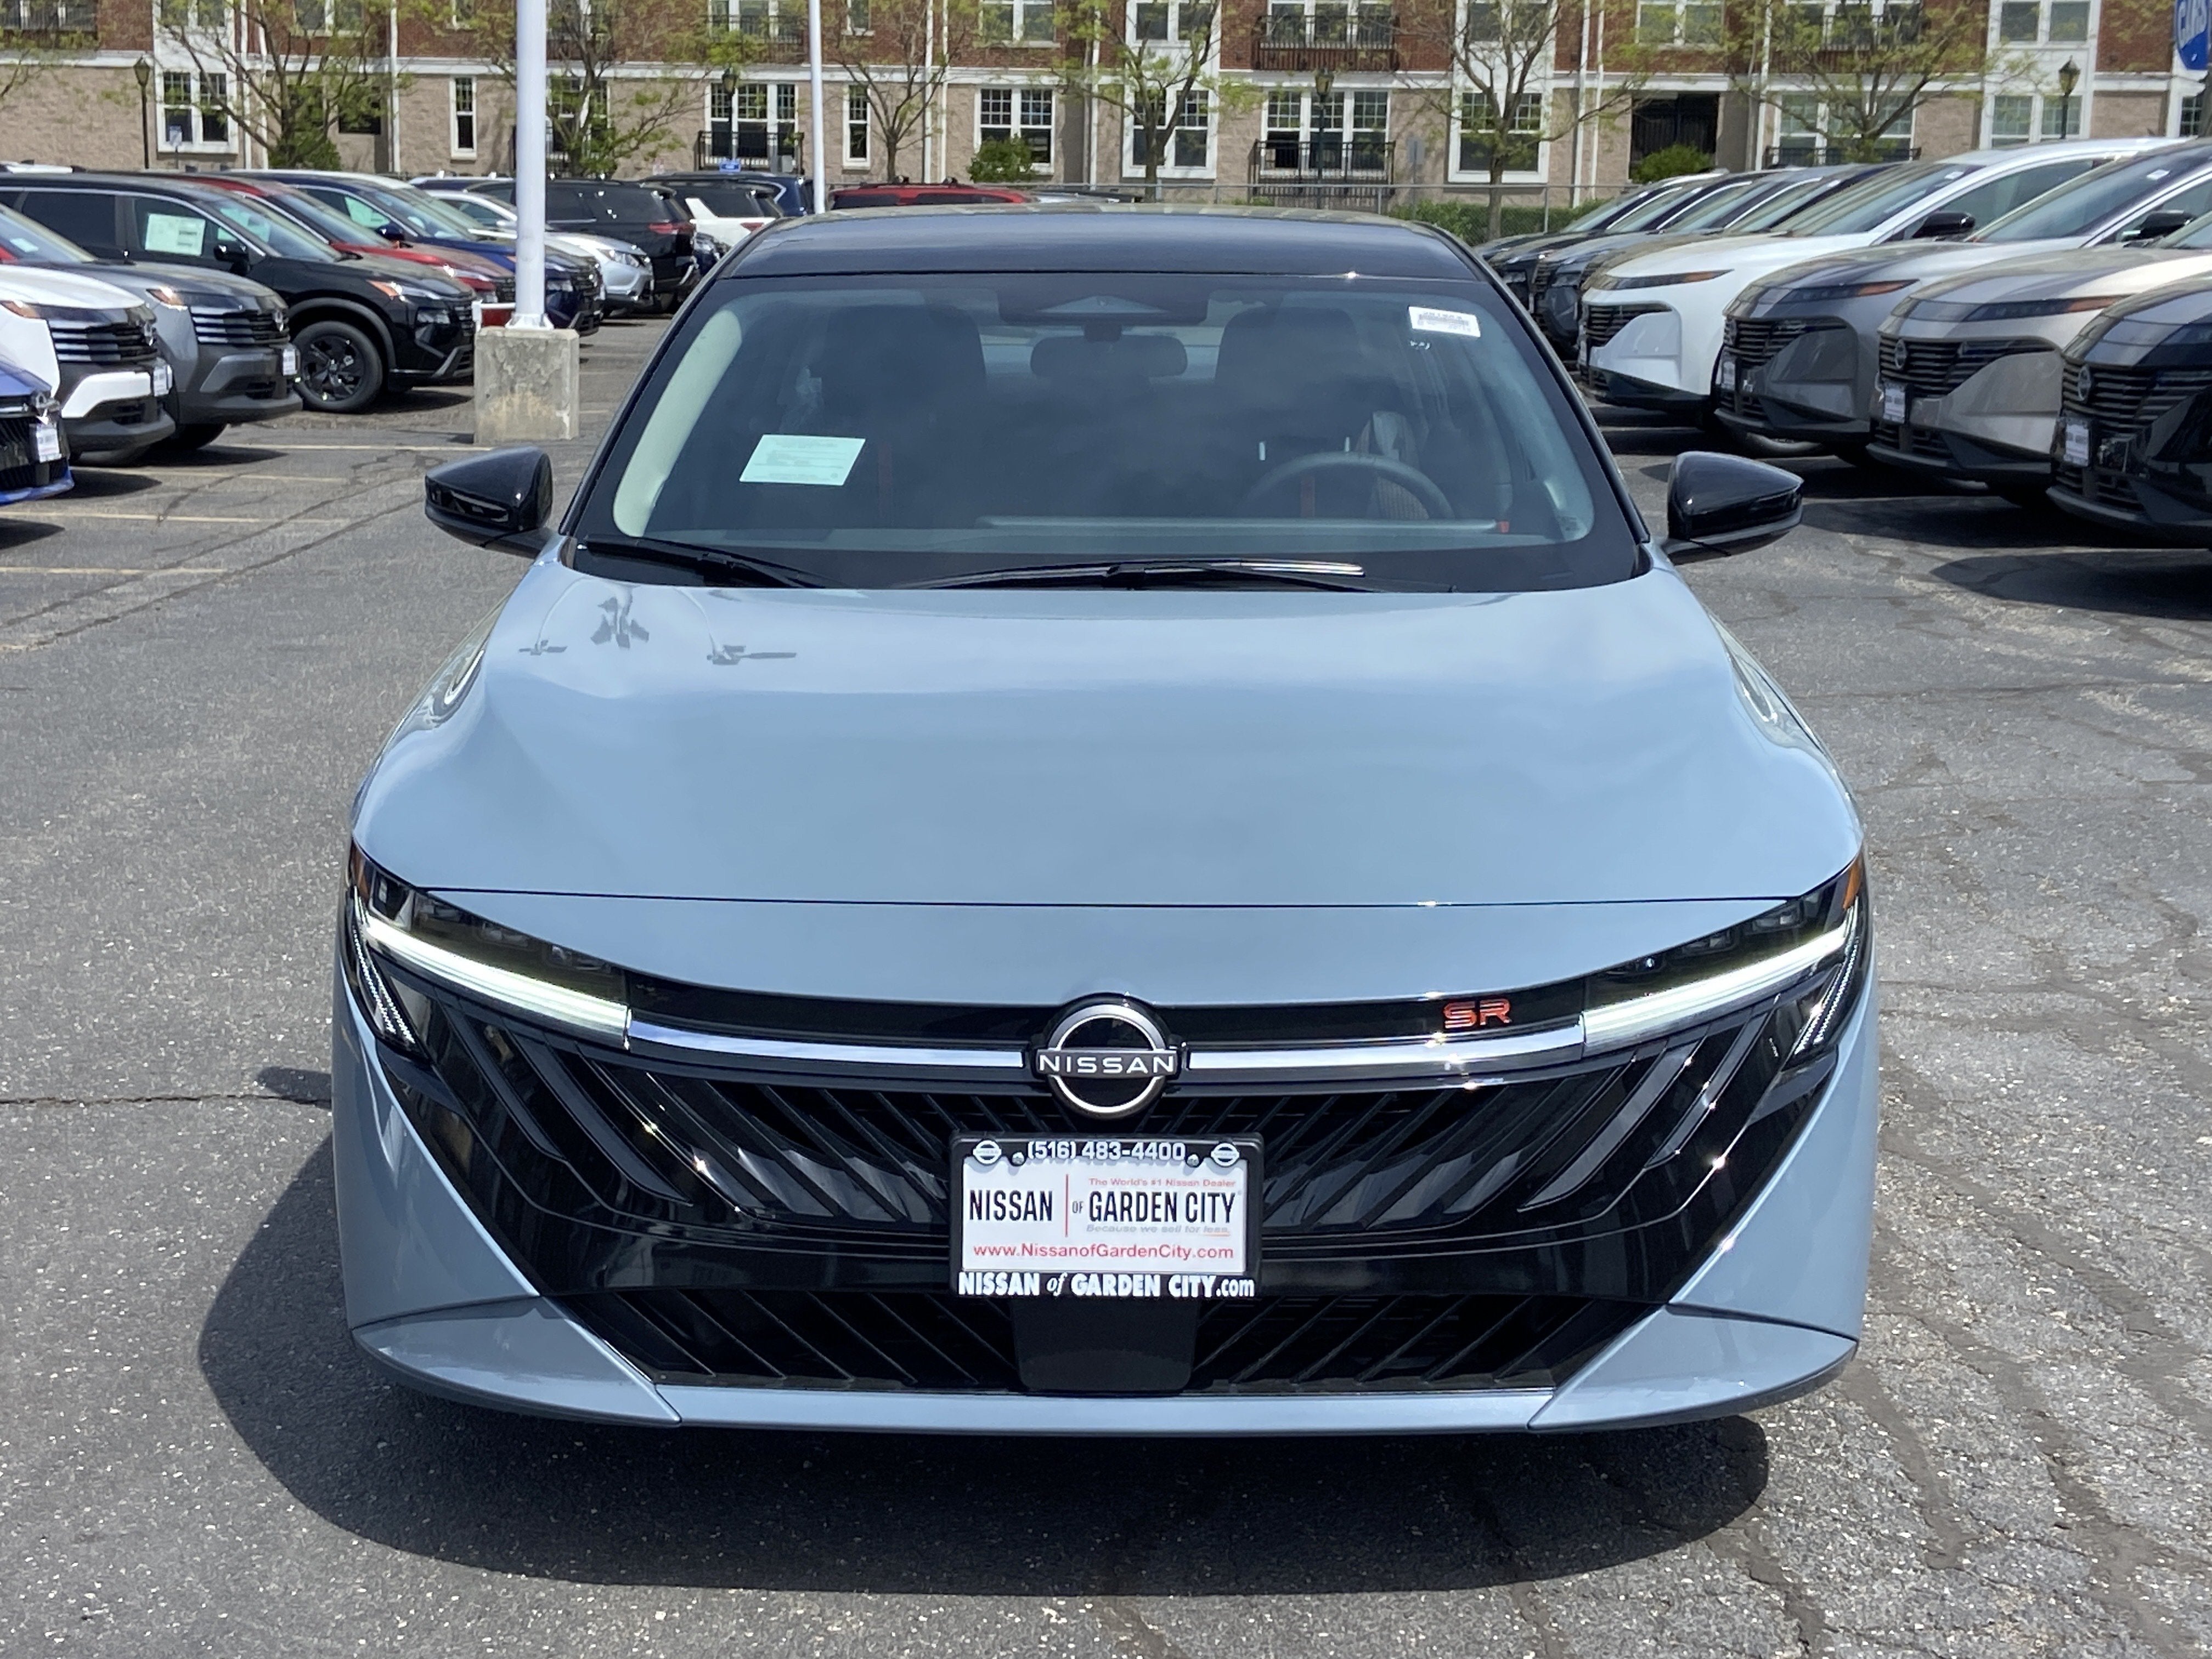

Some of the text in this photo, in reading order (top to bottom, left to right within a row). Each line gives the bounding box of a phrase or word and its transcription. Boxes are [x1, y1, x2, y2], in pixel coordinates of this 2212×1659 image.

[1443, 998, 1511, 1029] SR
[1039, 1054, 1173, 1074] NISSAN
[1028, 1141, 1186, 1160] (516) 483-4400
[1088, 1178, 1108, 1186] The
[1110, 1178, 1148, 1187] World's
[1150, 1178, 1162, 1187] #1
[1203, 1179, 1236, 1188] Dealer
[969, 1189, 1235, 1223] NISSAN OF GARDEN CITY
[1086, 1224, 1137, 1233] Because
[1185, 1224, 1201, 1233] for
[973, 1243, 1234, 1260] www.NissanofGardenCity.com
[958, 1272, 1255, 1297] NISSAN of GARDEN CITY.com
